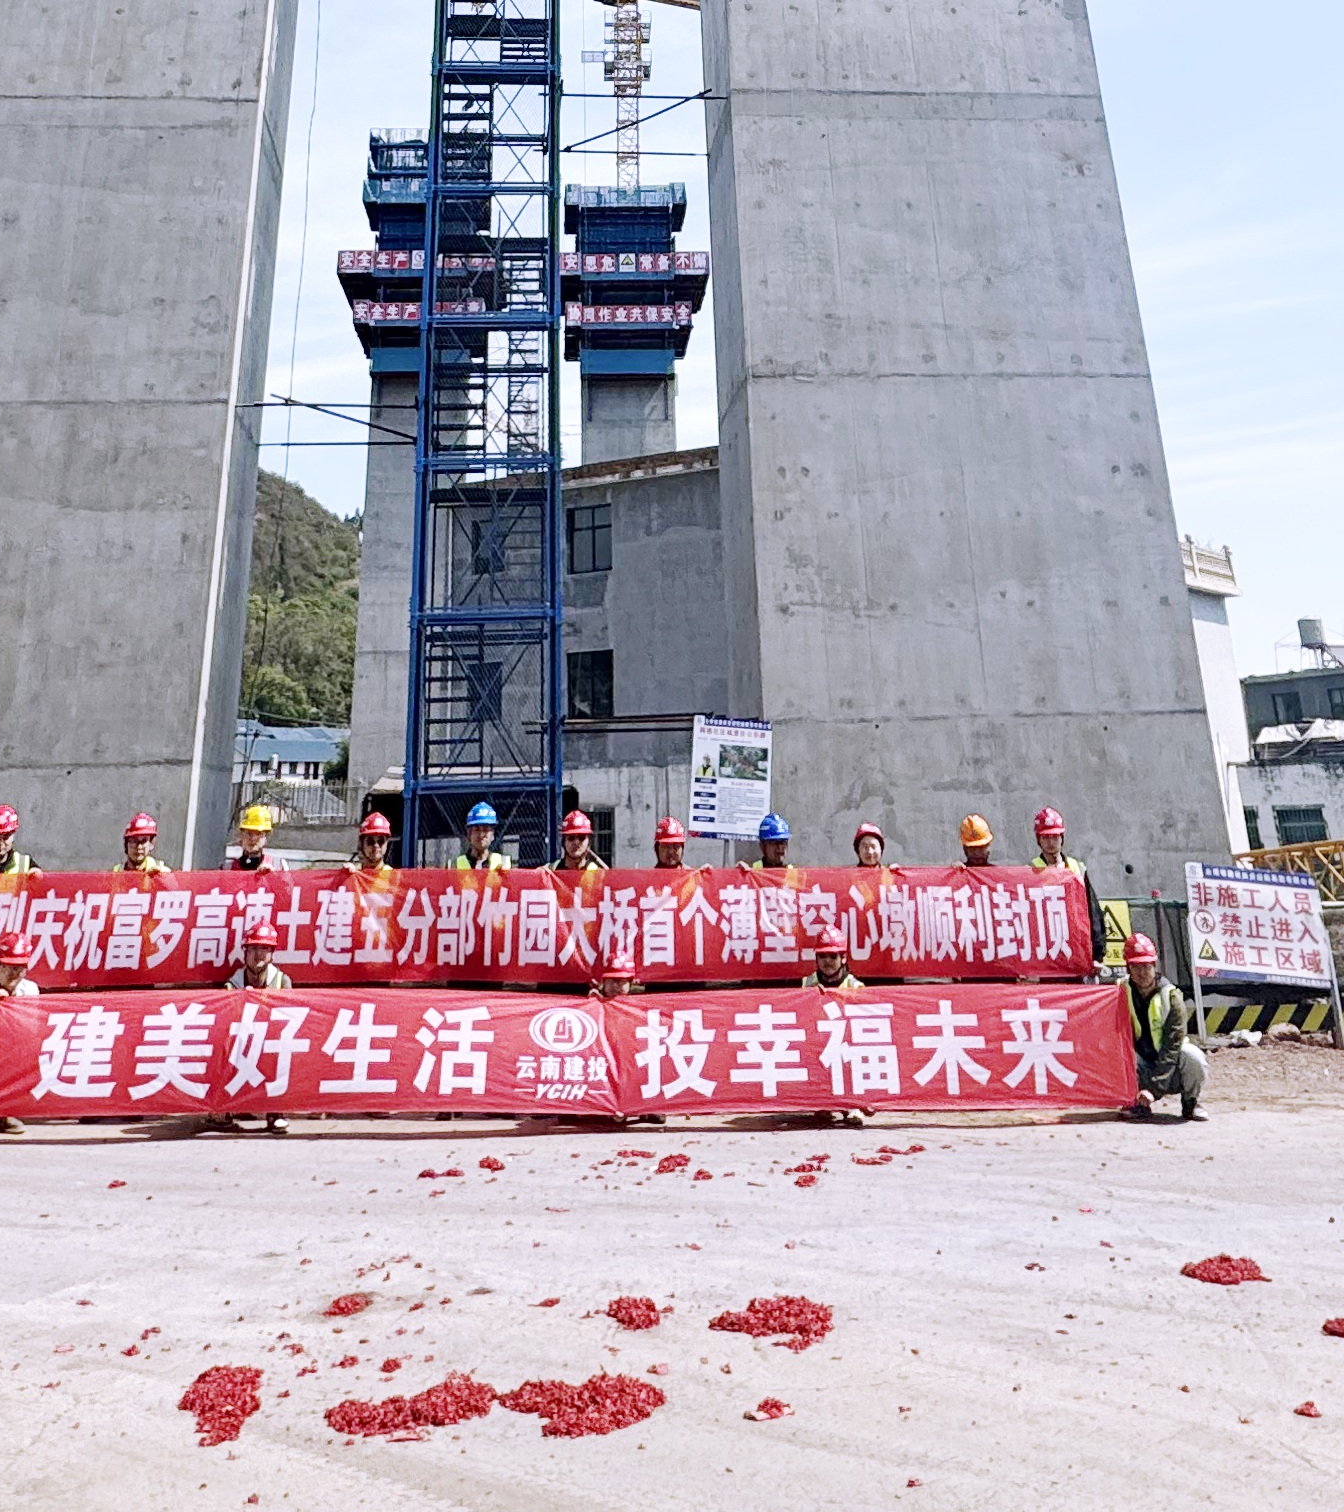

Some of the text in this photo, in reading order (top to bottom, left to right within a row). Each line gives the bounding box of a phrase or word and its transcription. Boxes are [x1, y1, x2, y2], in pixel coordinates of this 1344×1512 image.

[563, 252, 616, 272] 安思危
[1191, 881, 1314, 916] 非施工人员
[1218, 911, 1320, 945] 禁止进入
[1222, 941, 1325, 975] 施工区域
[32, 999, 1079, 1100] 建美好生活 投幸福未来
[516, 1055, 610, 1083] 云南建投
[535, 1084, 587, 1100] YCIH
